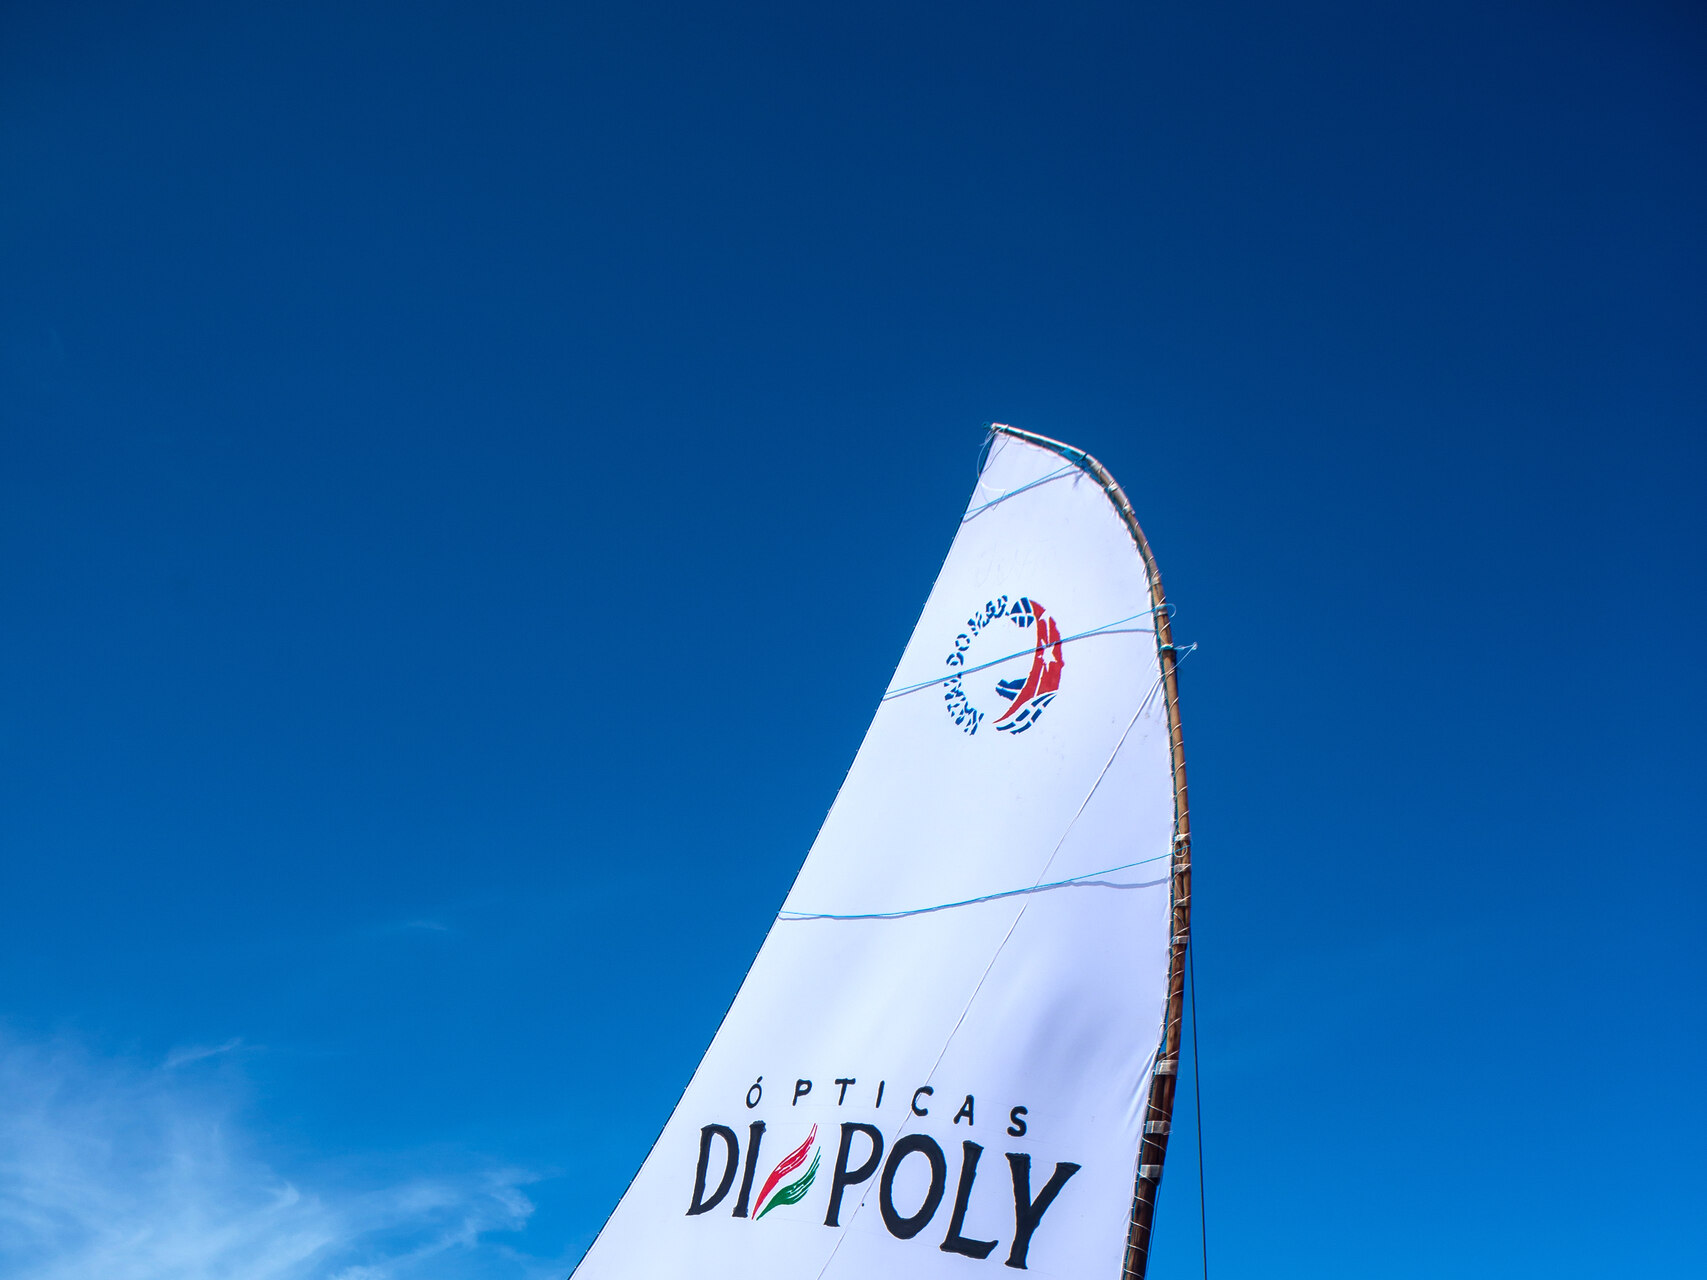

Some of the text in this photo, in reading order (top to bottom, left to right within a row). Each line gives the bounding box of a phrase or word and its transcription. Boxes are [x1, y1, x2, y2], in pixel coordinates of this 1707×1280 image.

[946, 633, 971, 667] DO
[745, 1076, 1029, 1138] ÓPTICAS
[823, 1121, 1082, 1270] POLY
